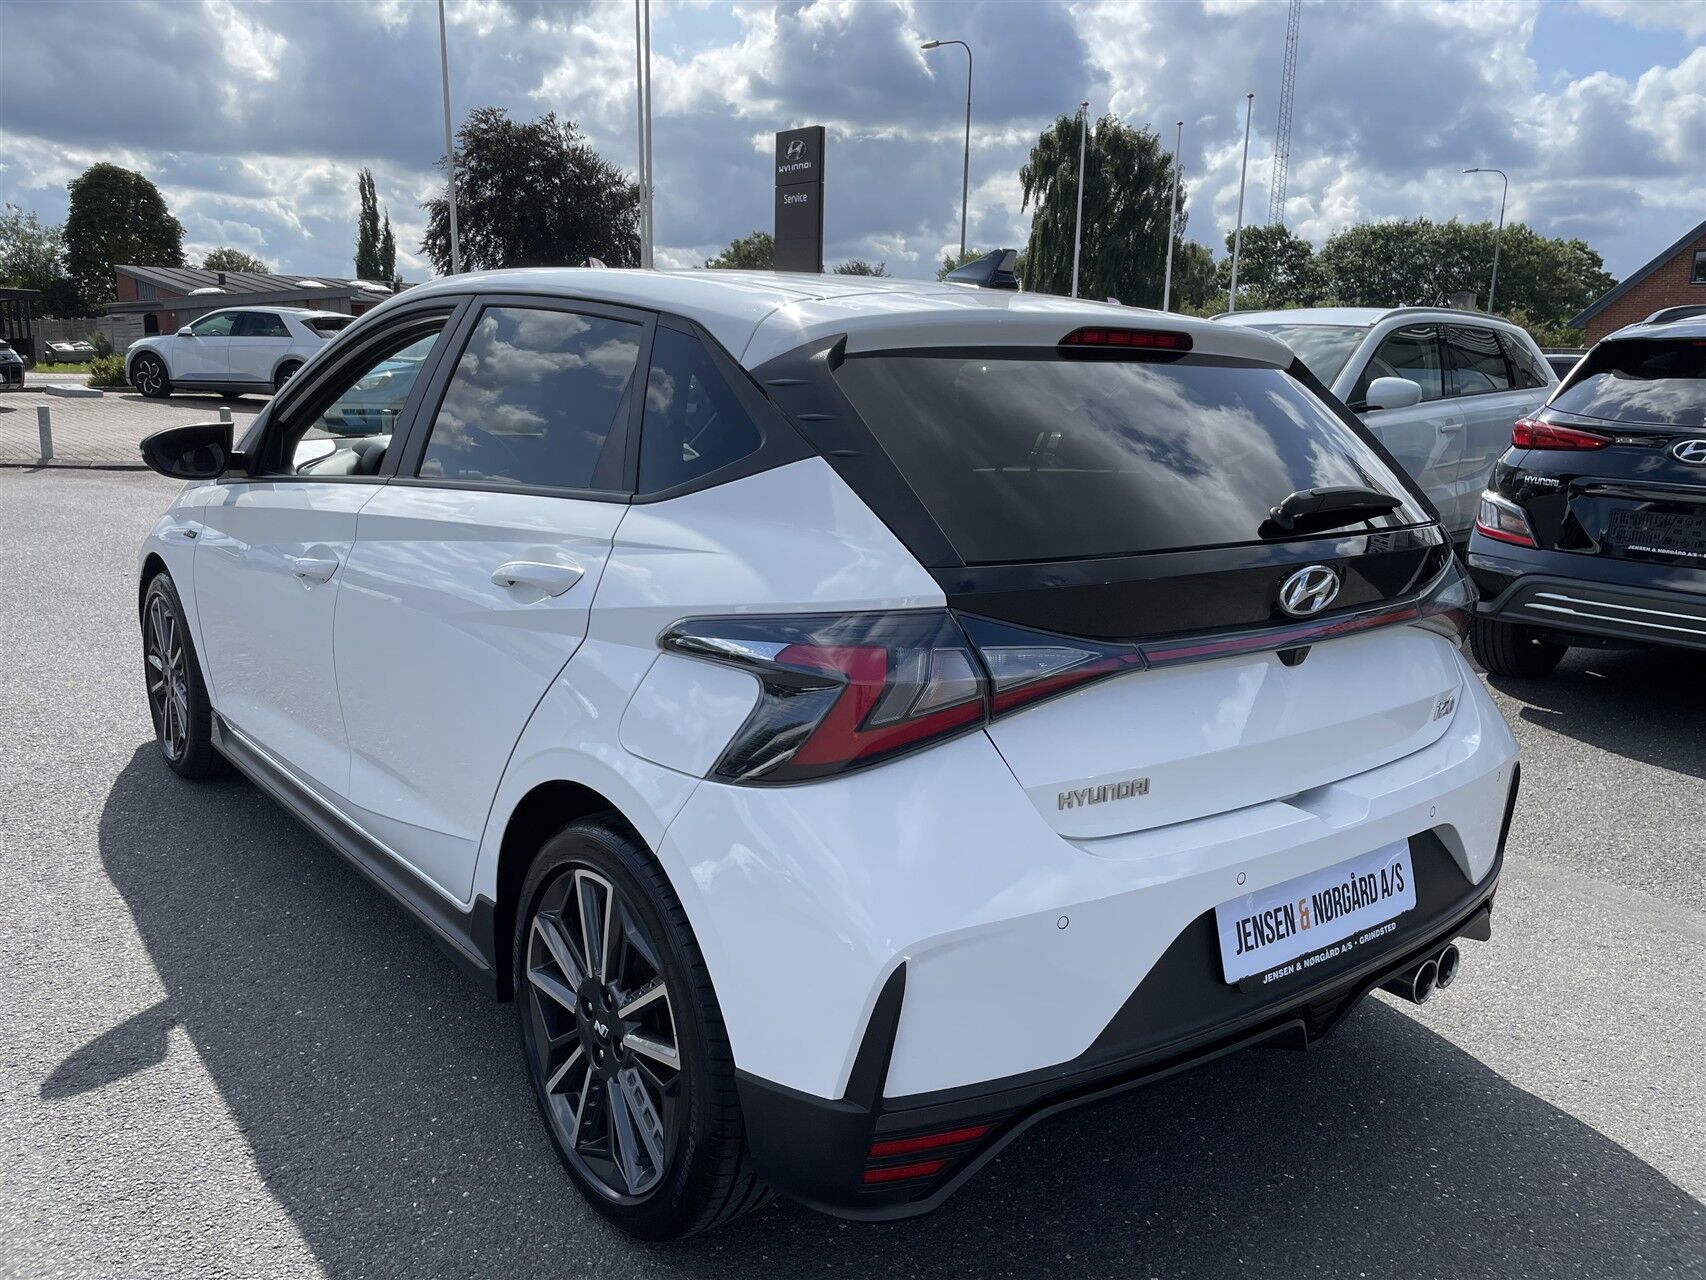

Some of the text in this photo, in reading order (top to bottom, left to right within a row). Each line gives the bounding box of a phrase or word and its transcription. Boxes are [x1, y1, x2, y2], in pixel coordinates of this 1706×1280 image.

[783, 193, 808, 204] Service
[1524, 475, 1560, 487] HYUNDAI
[1058, 777, 1150, 811] HYUNDAI
[1236, 862, 1405, 955] JENSEN & NØRGÅRD A/S
[1263, 922, 1397, 984] JENSEN & NØRGÅRD A/S GRINDSTED
